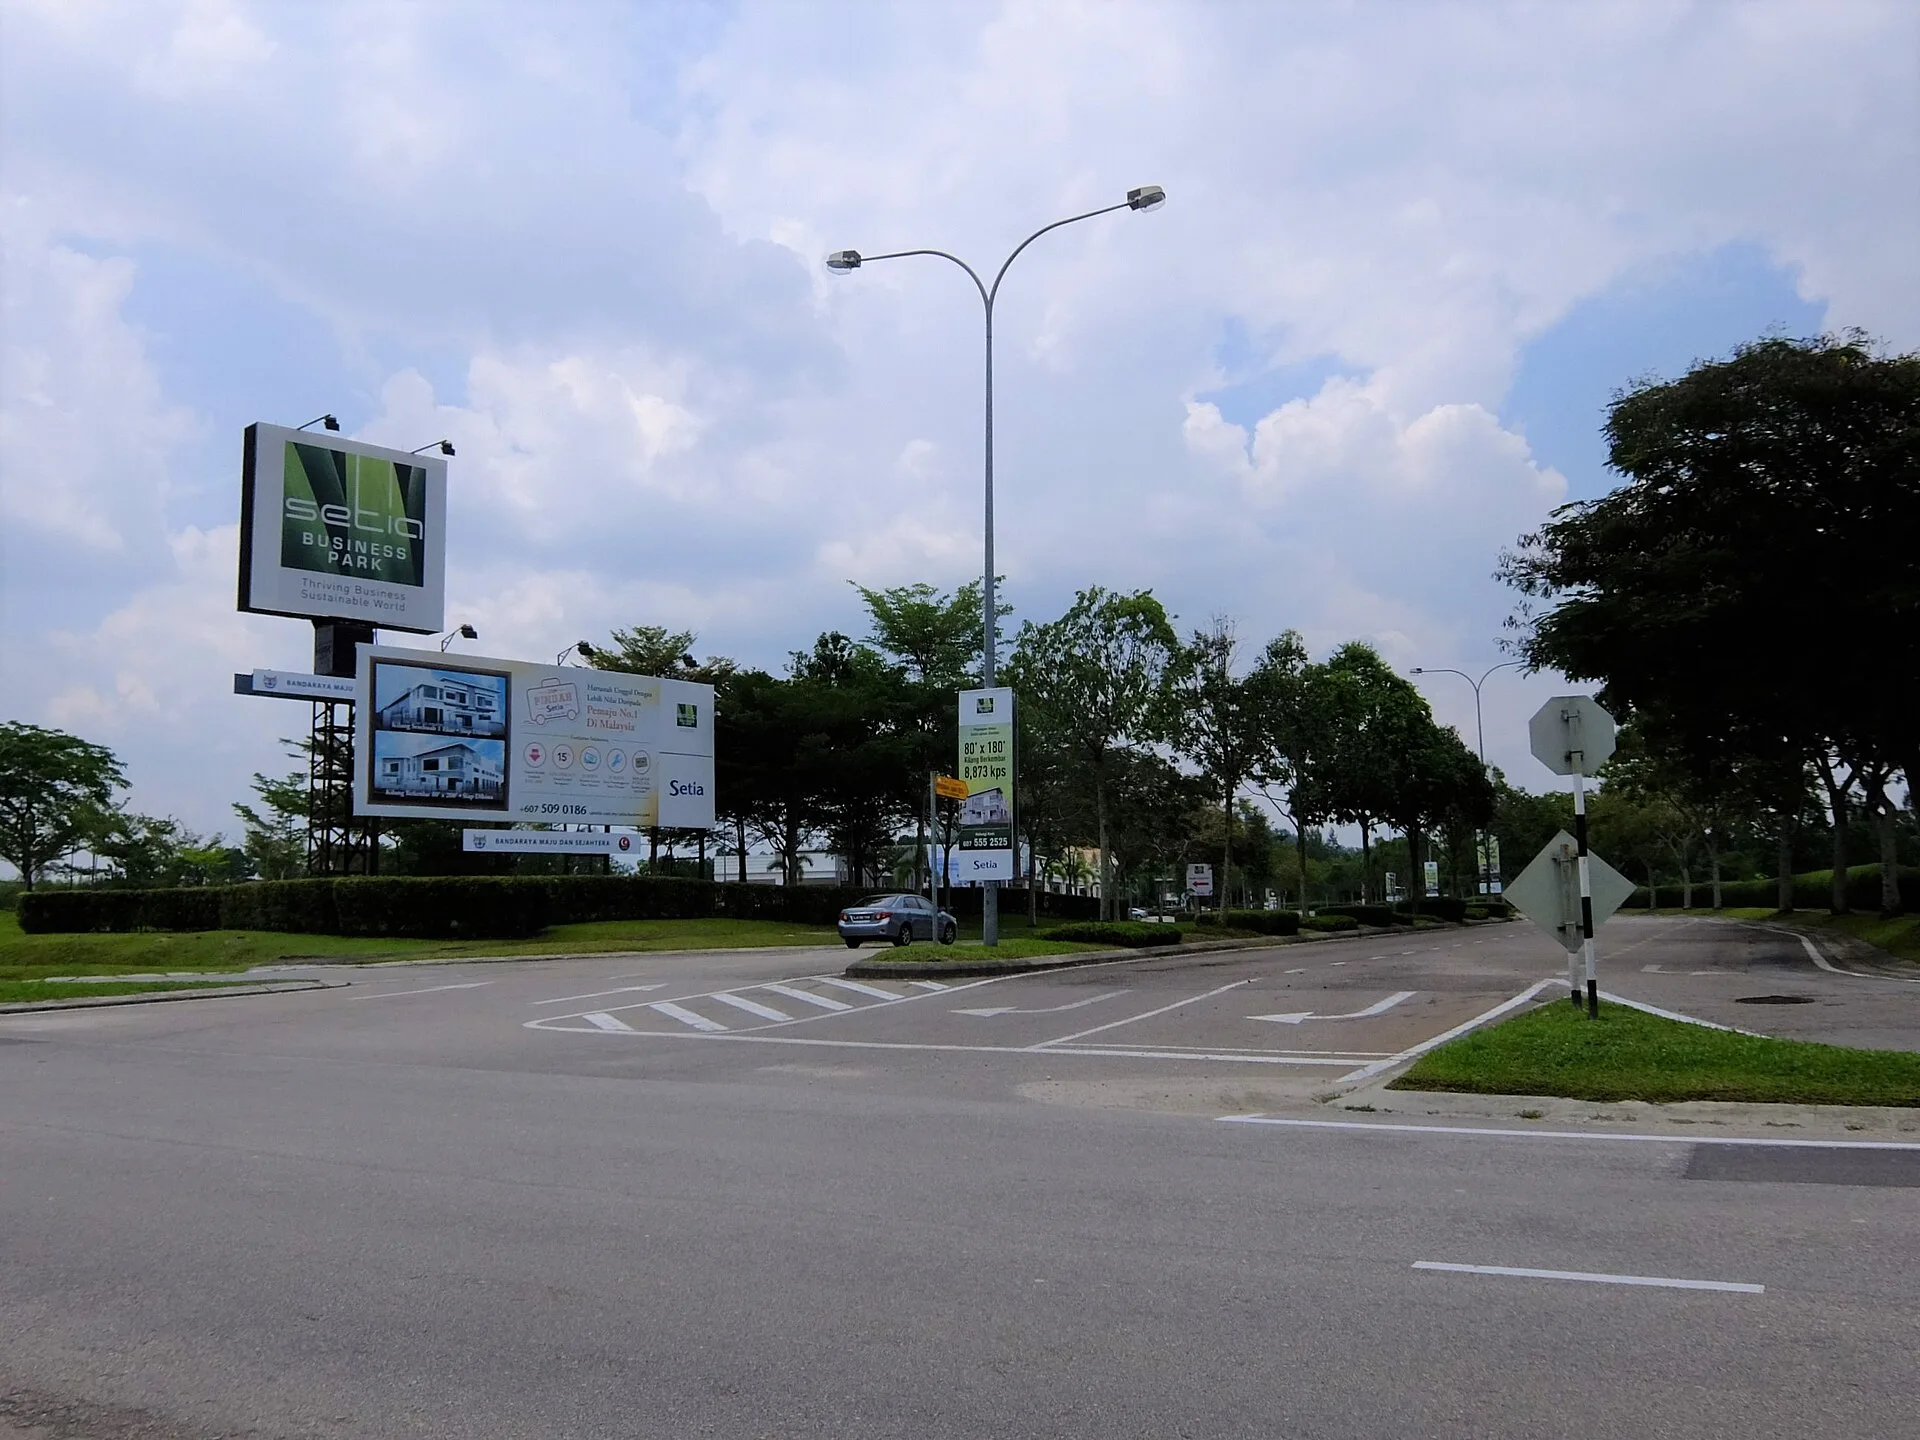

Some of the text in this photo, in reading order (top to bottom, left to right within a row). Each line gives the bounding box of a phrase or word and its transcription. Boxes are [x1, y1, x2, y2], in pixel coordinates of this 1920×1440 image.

[302, 532, 407, 560] BUSINESS
[328, 551, 382, 571] PARK
[302, 577, 406, 601] Thriving Business
[301, 590, 406, 612] Sustainable World
[286, 680, 331, 690] BANDARAYA
[587, 705, 638, 719] Pemaju No.1
[586, 718, 635, 732] Di Malaysia
[964, 765, 1006, 780] 8,873 kps
[669, 779, 704, 797] Setia
[520, 805, 539, 813] +607
[541, 803, 560, 814] 509
[562, 804, 587, 815] 0186
[973, 838, 988, 847] 555
[989, 837, 1008, 847] 2525
[973, 860, 998, 870] Setia
